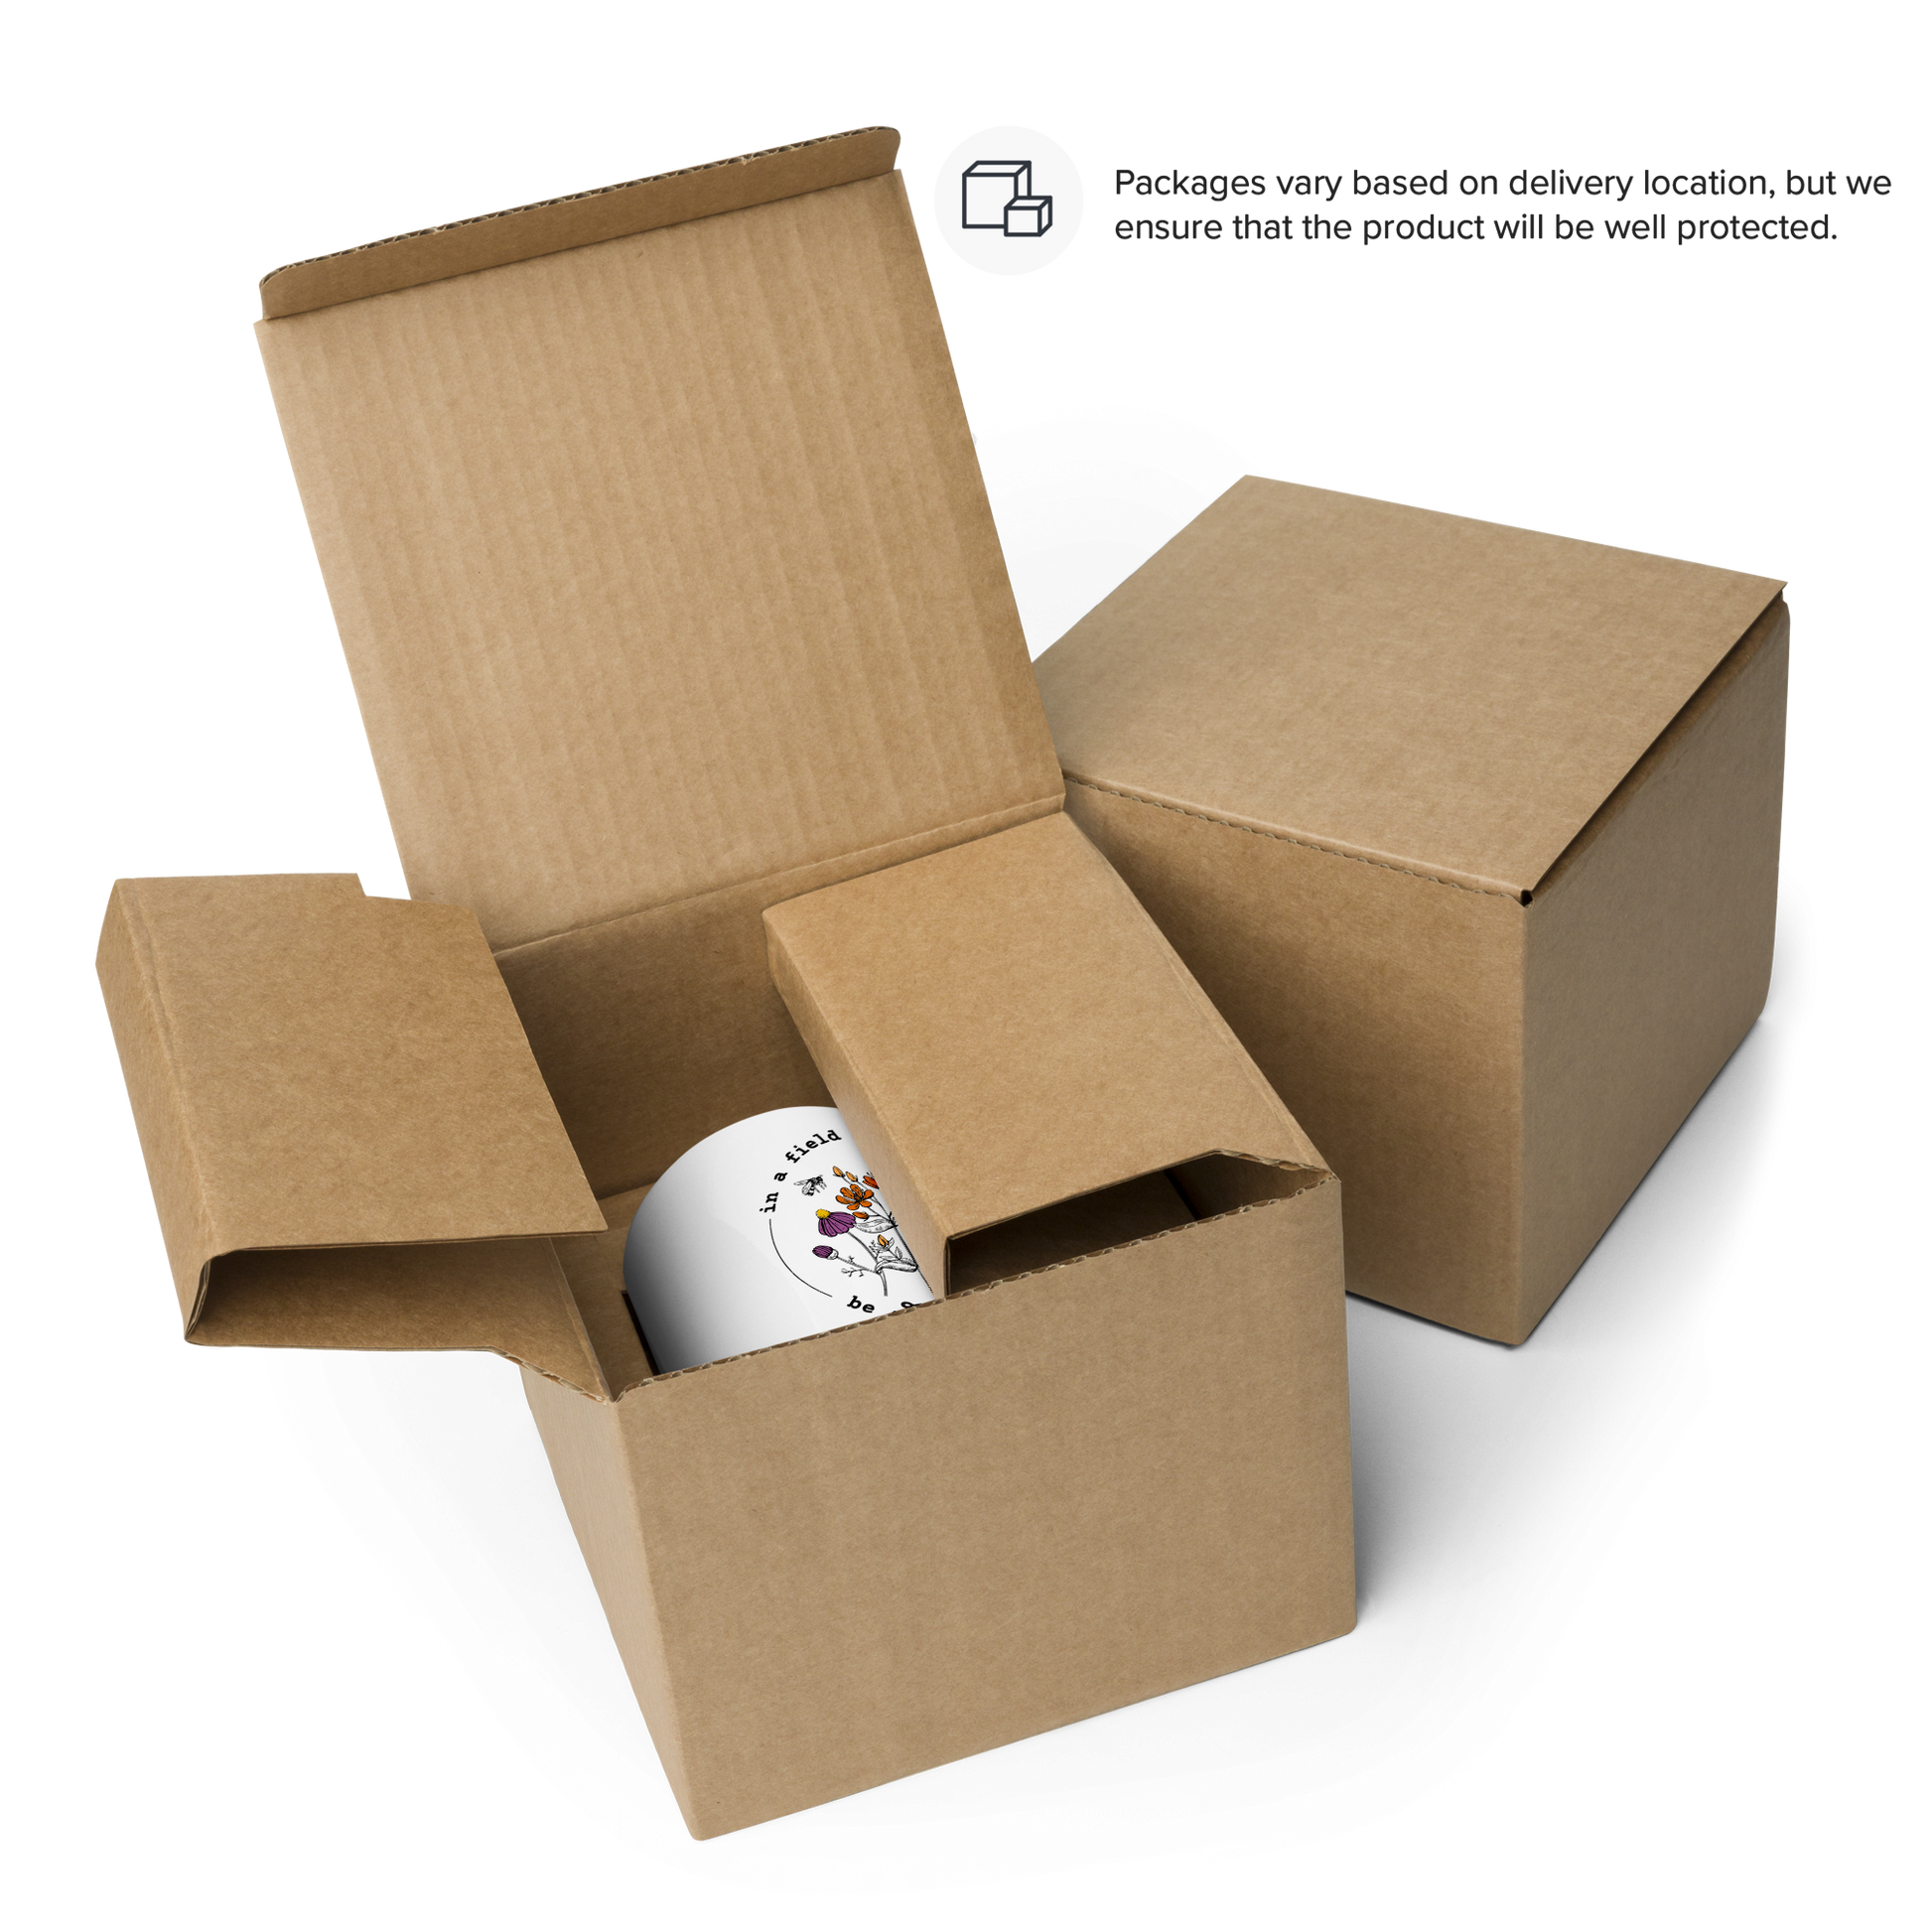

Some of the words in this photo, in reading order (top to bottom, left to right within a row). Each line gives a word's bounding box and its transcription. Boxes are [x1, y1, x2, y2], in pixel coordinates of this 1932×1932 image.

[759, 1191, 778, 1213] in
[773, 1172, 788, 1182] a
[785, 1129, 842, 1164] field
[847, 1296, 876, 1314] be
